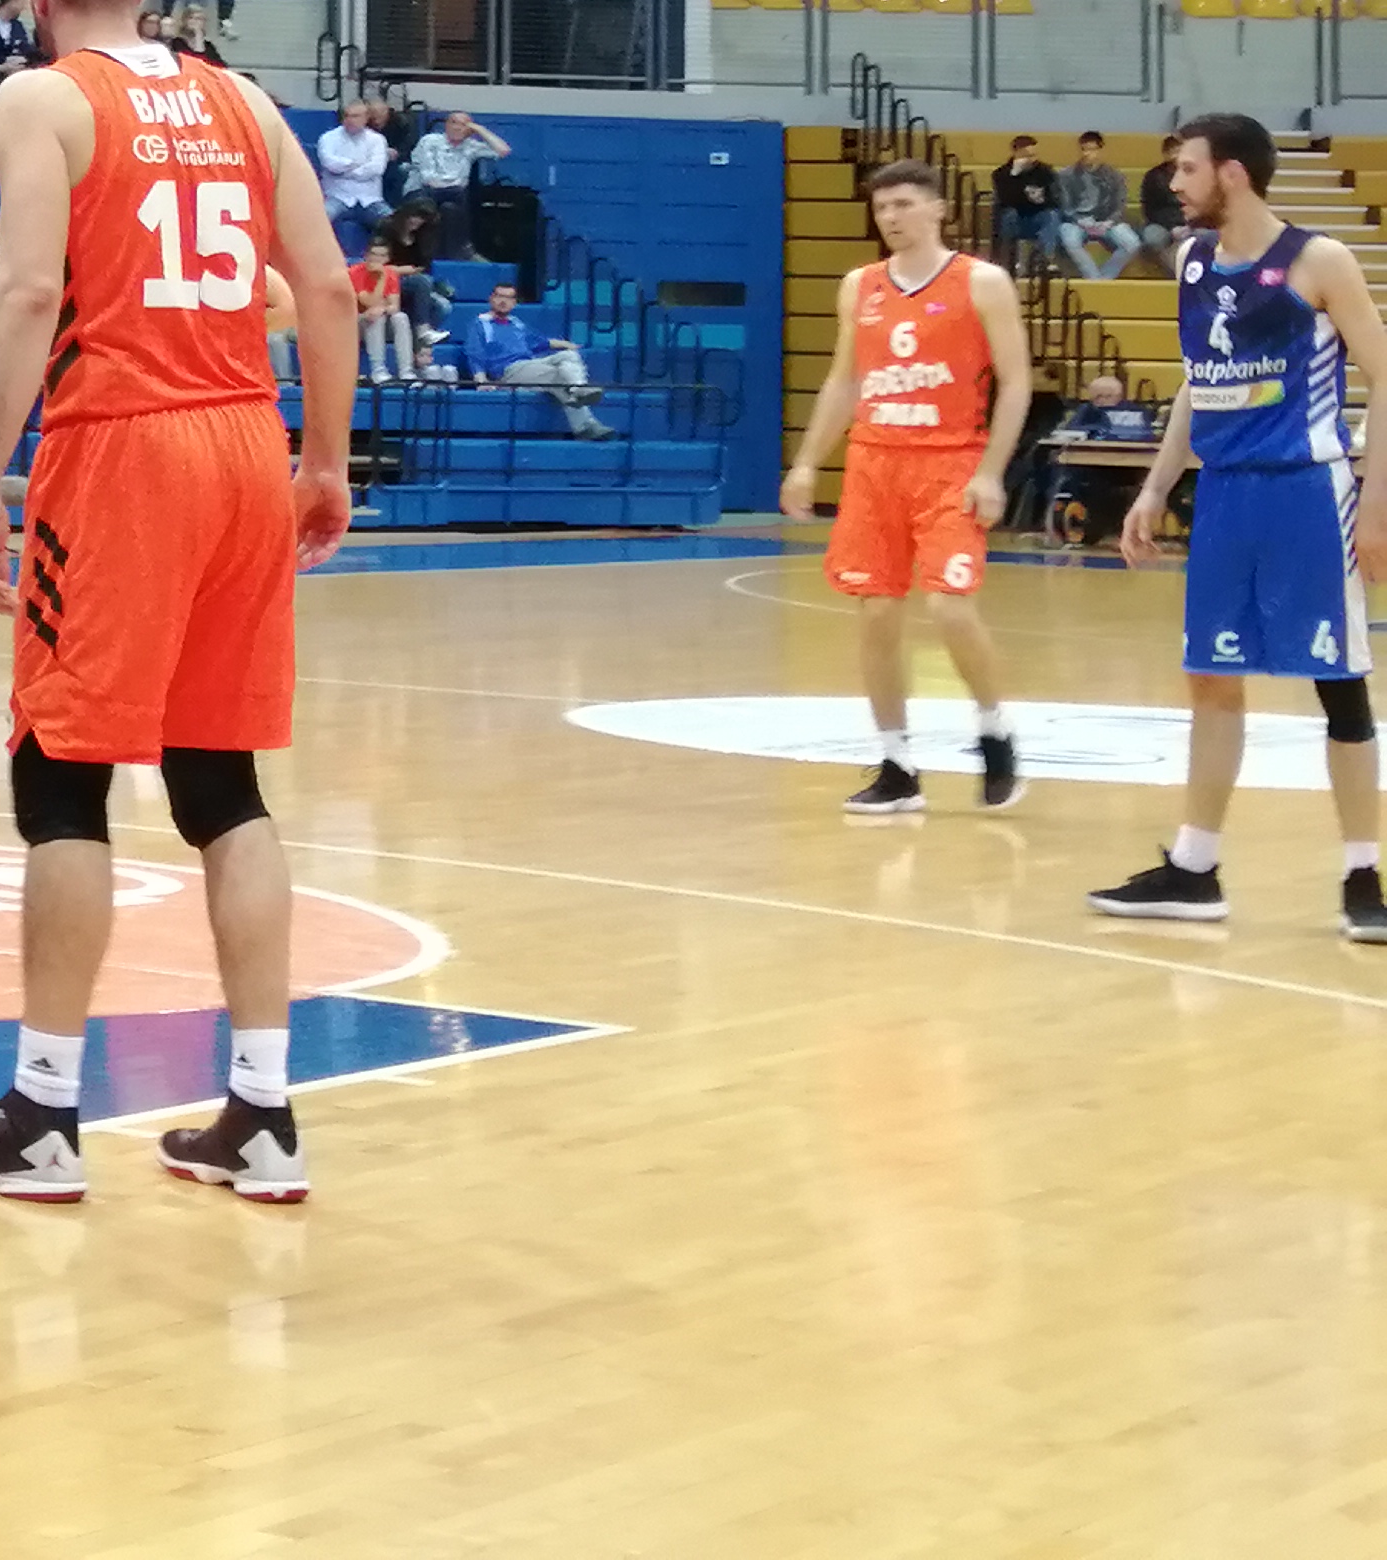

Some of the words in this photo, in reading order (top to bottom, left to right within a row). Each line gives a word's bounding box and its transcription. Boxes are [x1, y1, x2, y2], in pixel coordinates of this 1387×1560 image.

[126, 79, 214, 129] BANIĆ
[137, 179, 257, 312] 15
[889, 320, 918, 358] 6
[1208, 312, 1235, 358] 4
[943, 552, 974, 589] 6
[1309, 619, 1340, 666] 4
